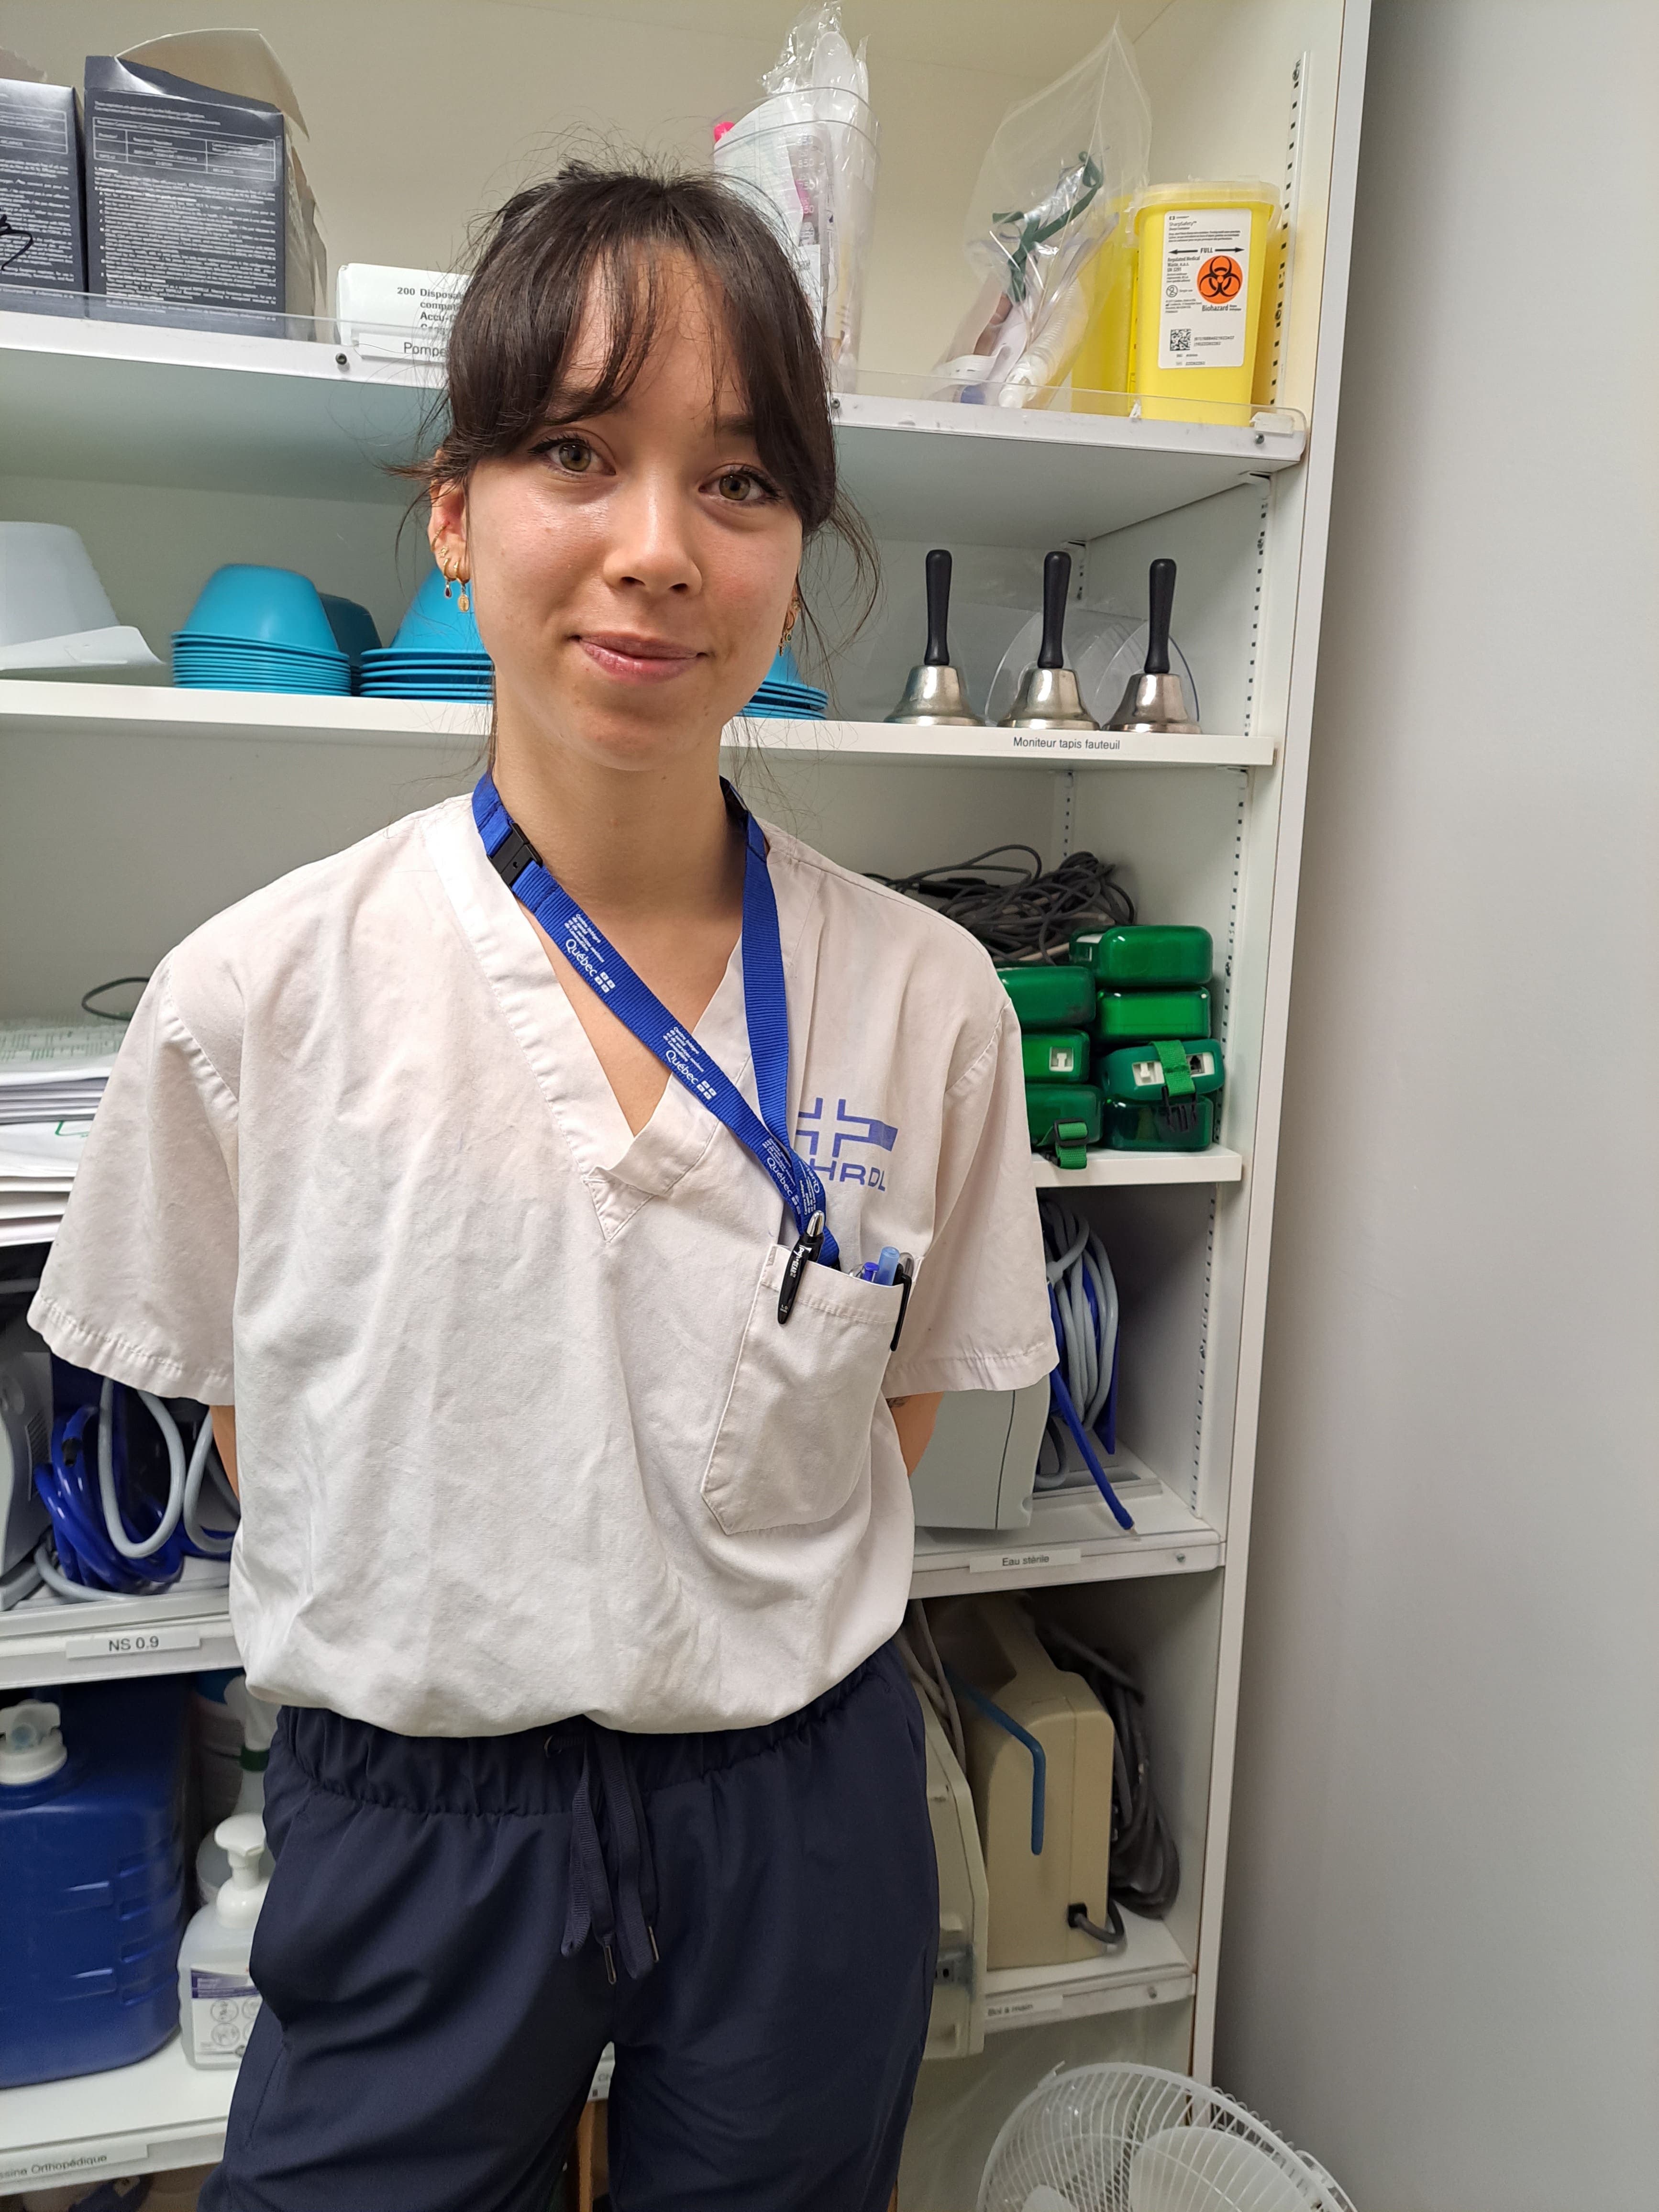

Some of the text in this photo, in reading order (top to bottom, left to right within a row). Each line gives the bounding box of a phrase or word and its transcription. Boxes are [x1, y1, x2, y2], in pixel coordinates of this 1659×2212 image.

[397, 287, 464, 299] 200 Disposa
[1013, 737, 1120, 750] Moniteur tapis fauteuil
[565, 939, 597, 977] Québec
[665, 1050, 699, 1085] Québec
[767, 1157, 793, 1196] Québec
[809, 1158, 886, 1192] HRDL
[1002, 1557, 1020, 1566] Eau
[108, 1636, 159, 1651] NS 0.9
[31, 2155, 108, 2174] Orthopédique
